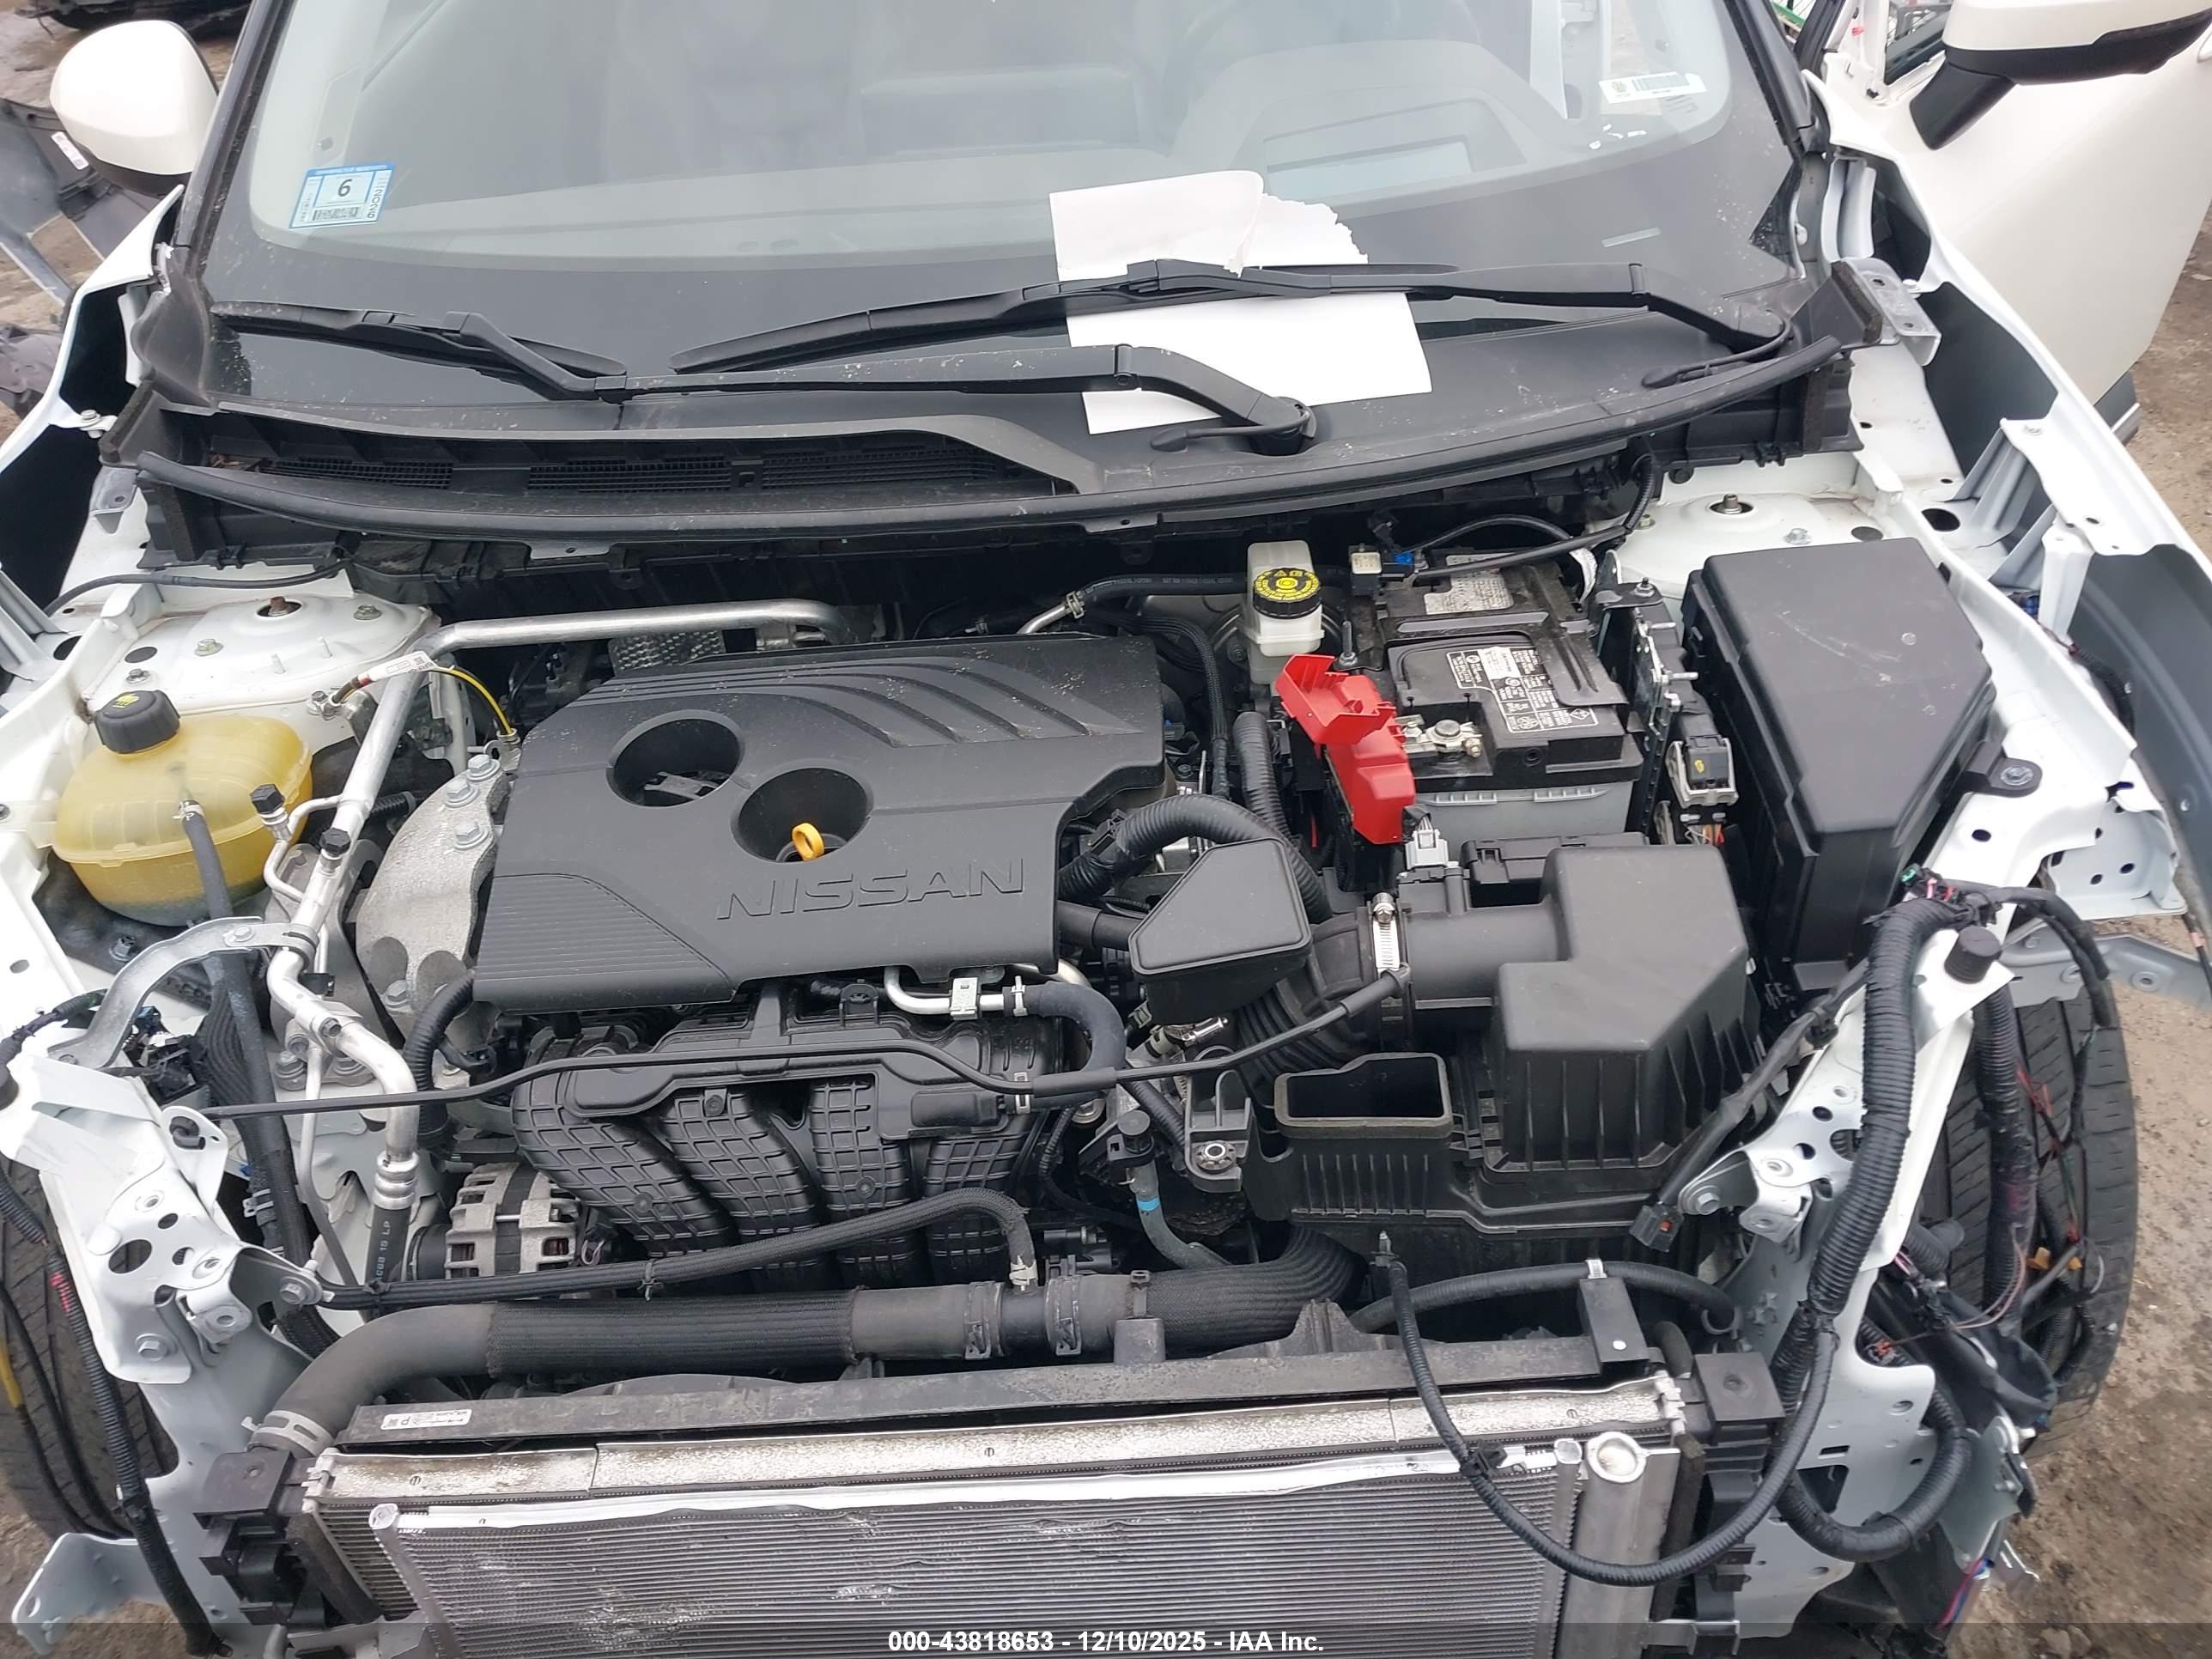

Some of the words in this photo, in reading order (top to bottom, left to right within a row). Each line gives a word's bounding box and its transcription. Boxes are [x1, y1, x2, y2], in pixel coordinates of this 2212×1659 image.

[337, 178, 353, 198] 6
[367, 188, 384, 218] 2026
[716, 858, 1024, 921] NISSAN
